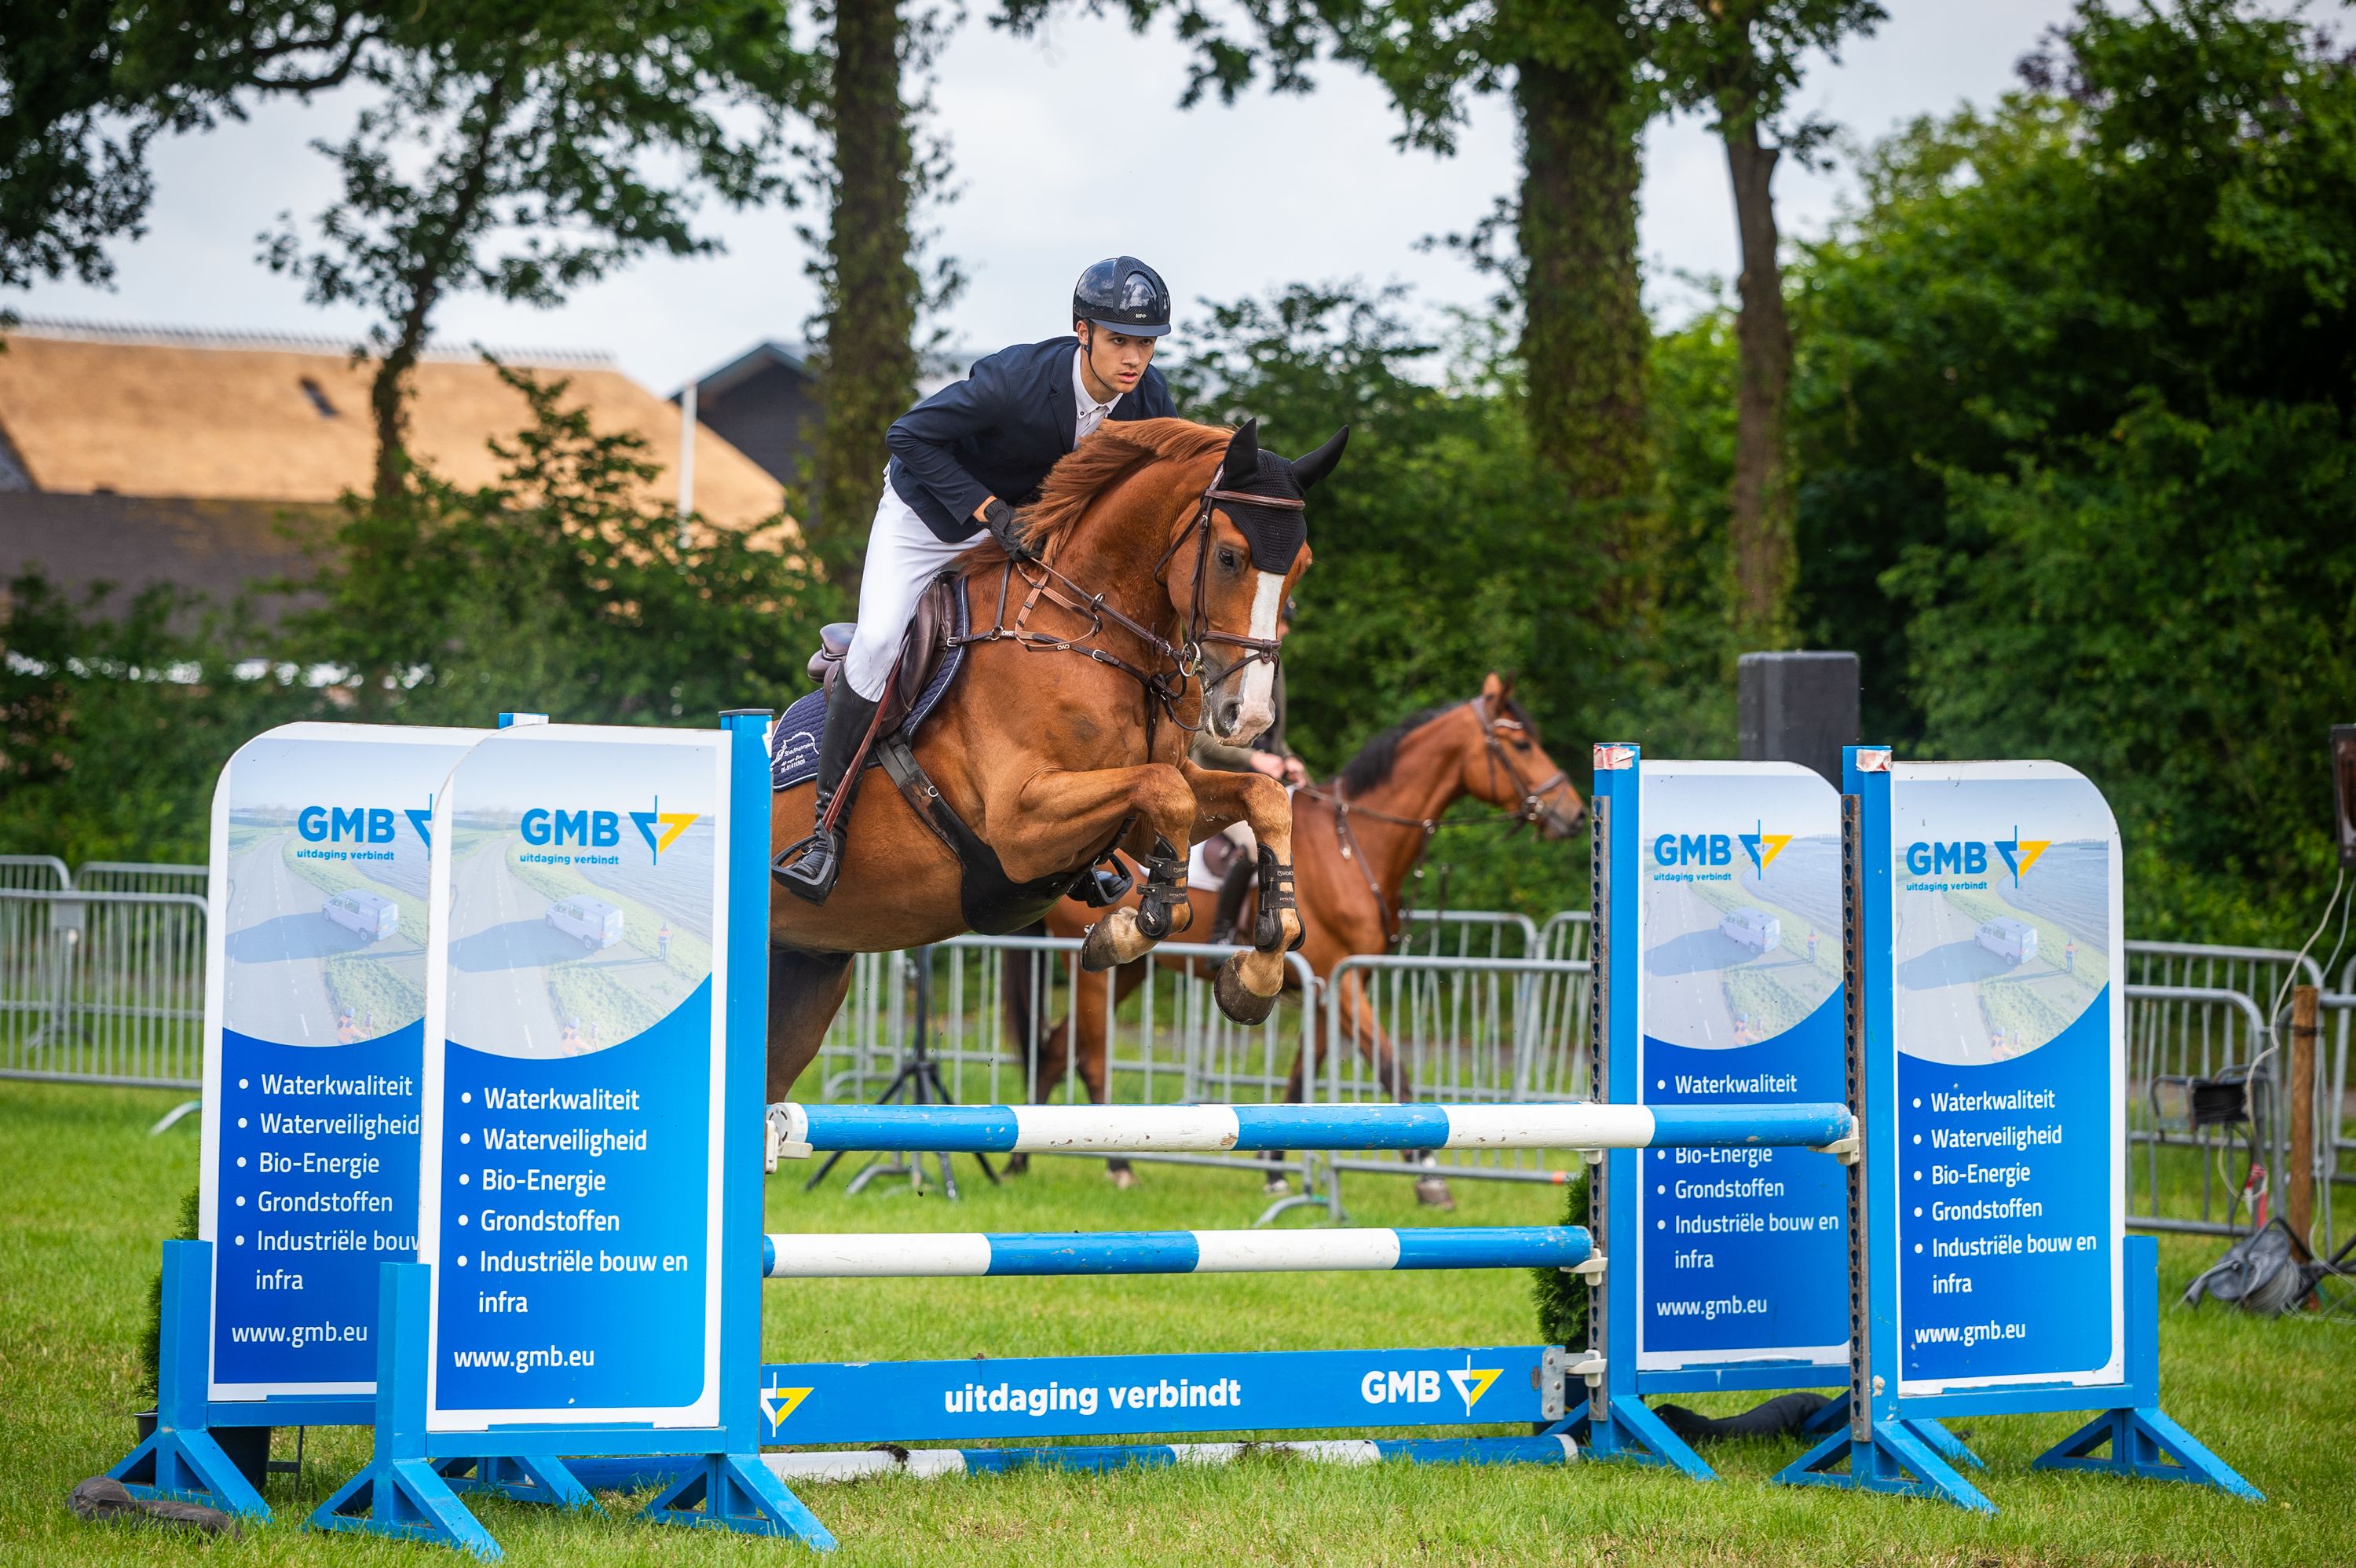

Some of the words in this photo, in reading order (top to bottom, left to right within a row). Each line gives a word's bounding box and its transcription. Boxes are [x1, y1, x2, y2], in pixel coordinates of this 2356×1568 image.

[298, 806, 395, 843] GMB
[521, 809, 620, 847] GMB
[296, 850, 346, 861] uitdaging
[349, 850, 395, 861] verbindt
[520, 854, 570, 865] uitdaging
[574, 854, 619, 865] verbindt
[1654, 834, 1732, 866] GMB
[1906, 842, 1988, 875] GMB
[1653, 873, 1694, 883] uitdaging
[1906, 883, 1948, 892] uitdaging
[262, 1074, 412, 1095] Waterkwaliteit
[1676, 1074, 1797, 1093] Waterkwaliteit
[485, 1087, 639, 1110] Waterkwaliteit
[1931, 1090, 2054, 1112] Waterkwaliteit
[261, 1113, 419, 1140] Waterveiligheid
[1932, 1125, 2062, 1150] Waterveiligheid
[484, 1128, 646, 1157] Waterveiligheid
[260, 1153, 379, 1179] Bio-Energie
[1676, 1147, 1772, 1168] Bio-Energie
[483, 1169, 605, 1197] Bio-Energie
[1933, 1162, 2030, 1187] Bio-Energie
[1676, 1179, 1783, 1198] Grondstoffen
[258, 1191, 392, 1212] Grondstoffen
[1933, 1198, 2042, 1221] Grondstoffen
[481, 1209, 619, 1231] Grondstoffen
[1677, 1214, 1763, 1233] Industriële
[1770, 1213, 1813, 1231] bouw
[1820, 1216, 1838, 1230] en
[258, 1230, 366, 1250] Industriële
[1933, 1235, 2021, 1257] Industriële
[2028, 1234, 2072, 1252] bouw
[2077, 1236, 2096, 1250] en
[481, 1250, 593, 1271] Industriële
[600, 1250, 657, 1271] bouw
[663, 1255, 687, 1271] en
[1676, 1250, 1713, 1268] infra
[257, 1269, 302, 1289] infra
[1933, 1274, 1972, 1293] infra
[480, 1291, 528, 1312] infra
[1657, 1296, 1766, 1319] www.gmb.eu
[232, 1321, 367, 1347] www.gmb.eu
[1915, 1321, 2025, 1345] www.gmb.eu
[455, 1345, 594, 1373] www.gmb.eu
[946, 1382, 1098, 1416] uitdaging
[1108, 1379, 1240, 1409] verbindt
[1362, 1371, 1440, 1403] GMB
